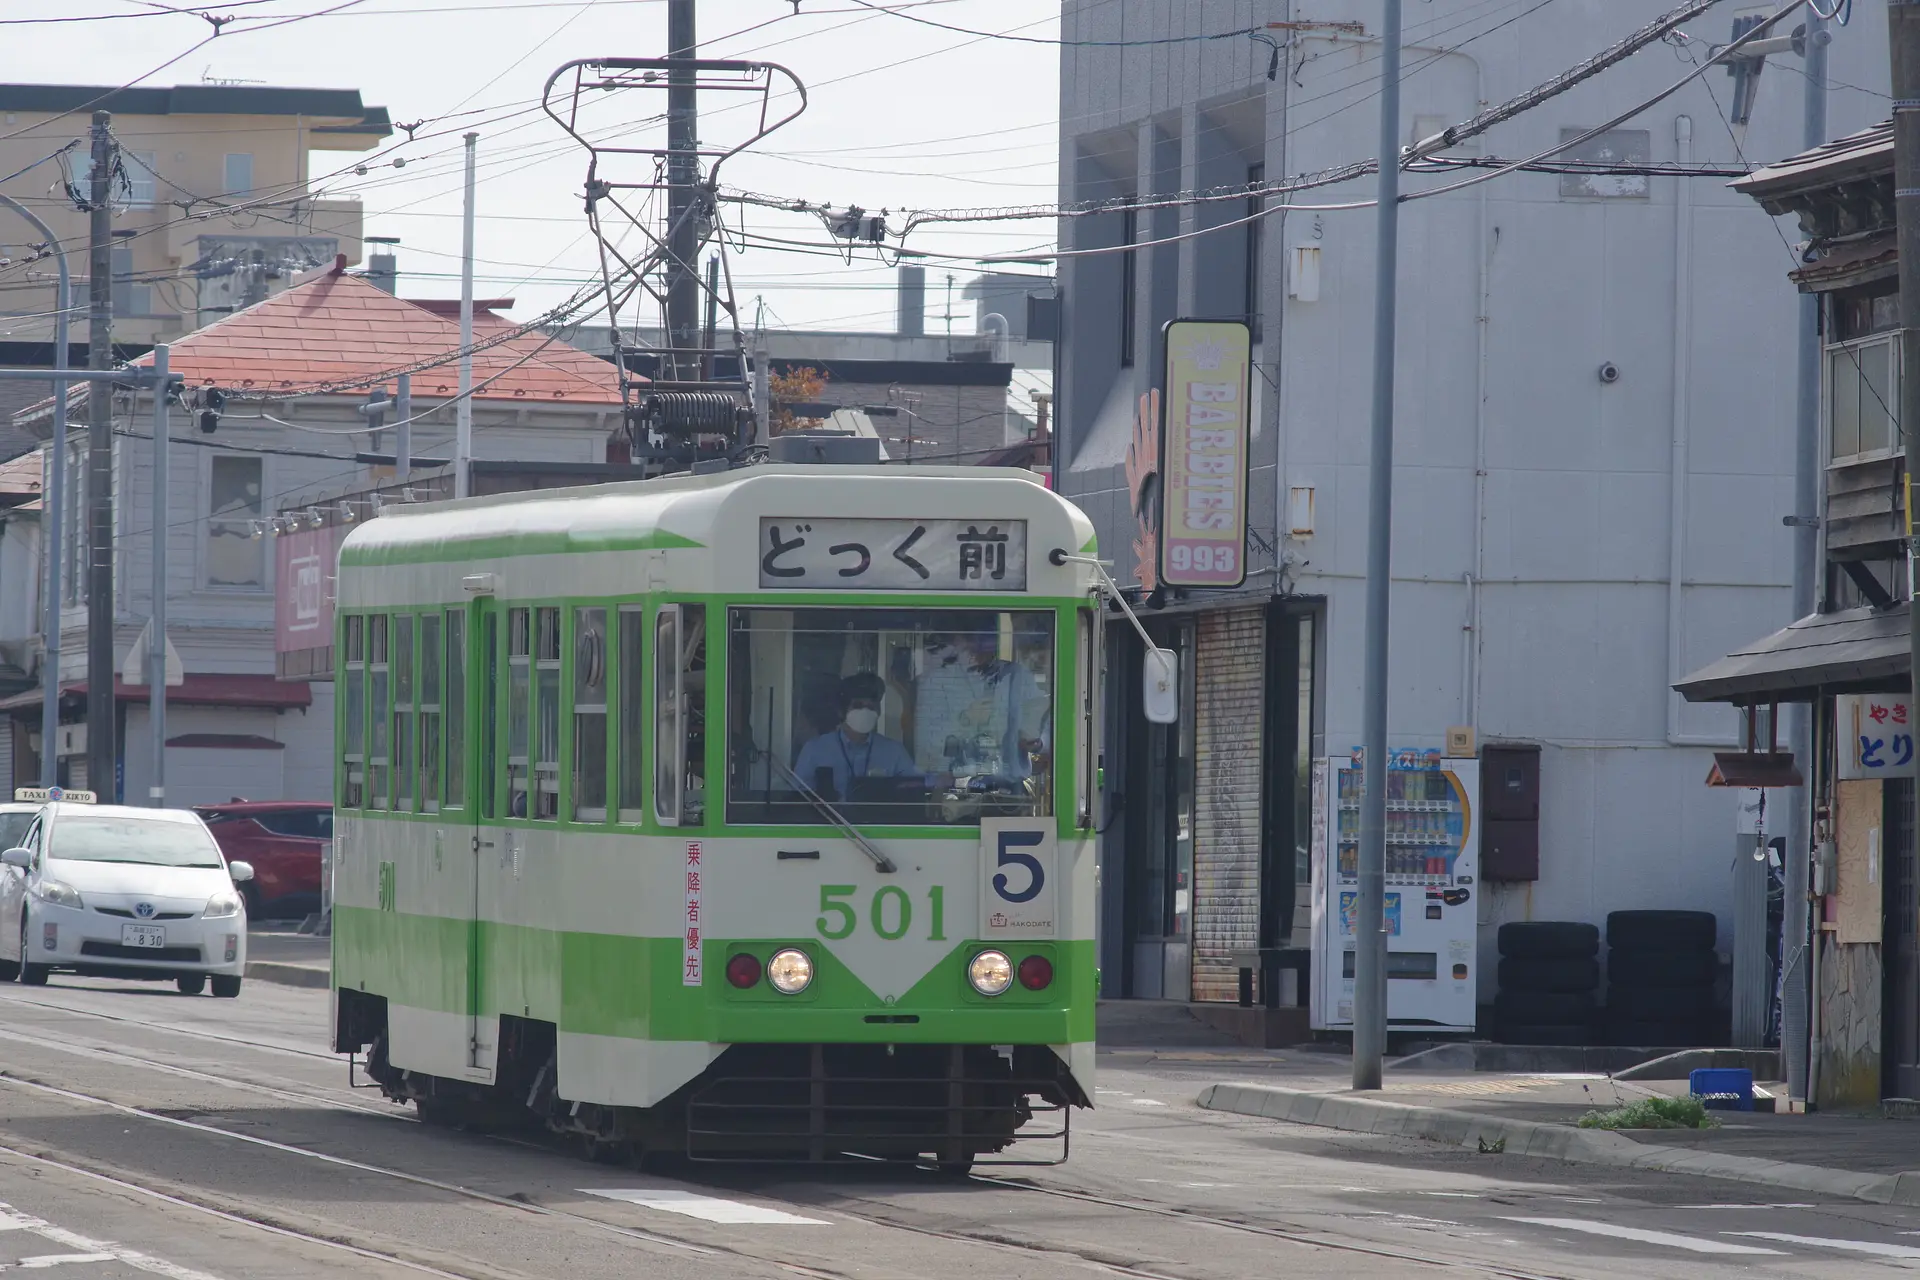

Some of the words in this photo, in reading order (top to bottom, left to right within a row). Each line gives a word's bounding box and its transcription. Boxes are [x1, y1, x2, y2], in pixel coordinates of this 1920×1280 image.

[1182, 381, 1238, 530] BARBIES
[763, 525, 1009, 580] どっく前
[1171, 545, 1235, 572] 993
[1869, 701, 1908, 724] やき
[1860, 734, 1914, 767] とり
[22, 791, 46, 799] TAXI
[65, 793, 91, 801] KIKYO
[992, 831, 1046, 904] 5
[686, 843, 701, 978] 乗降者優先
[815, 884, 947, 941] 501
[1010, 920, 1052, 928] HAKODATE
